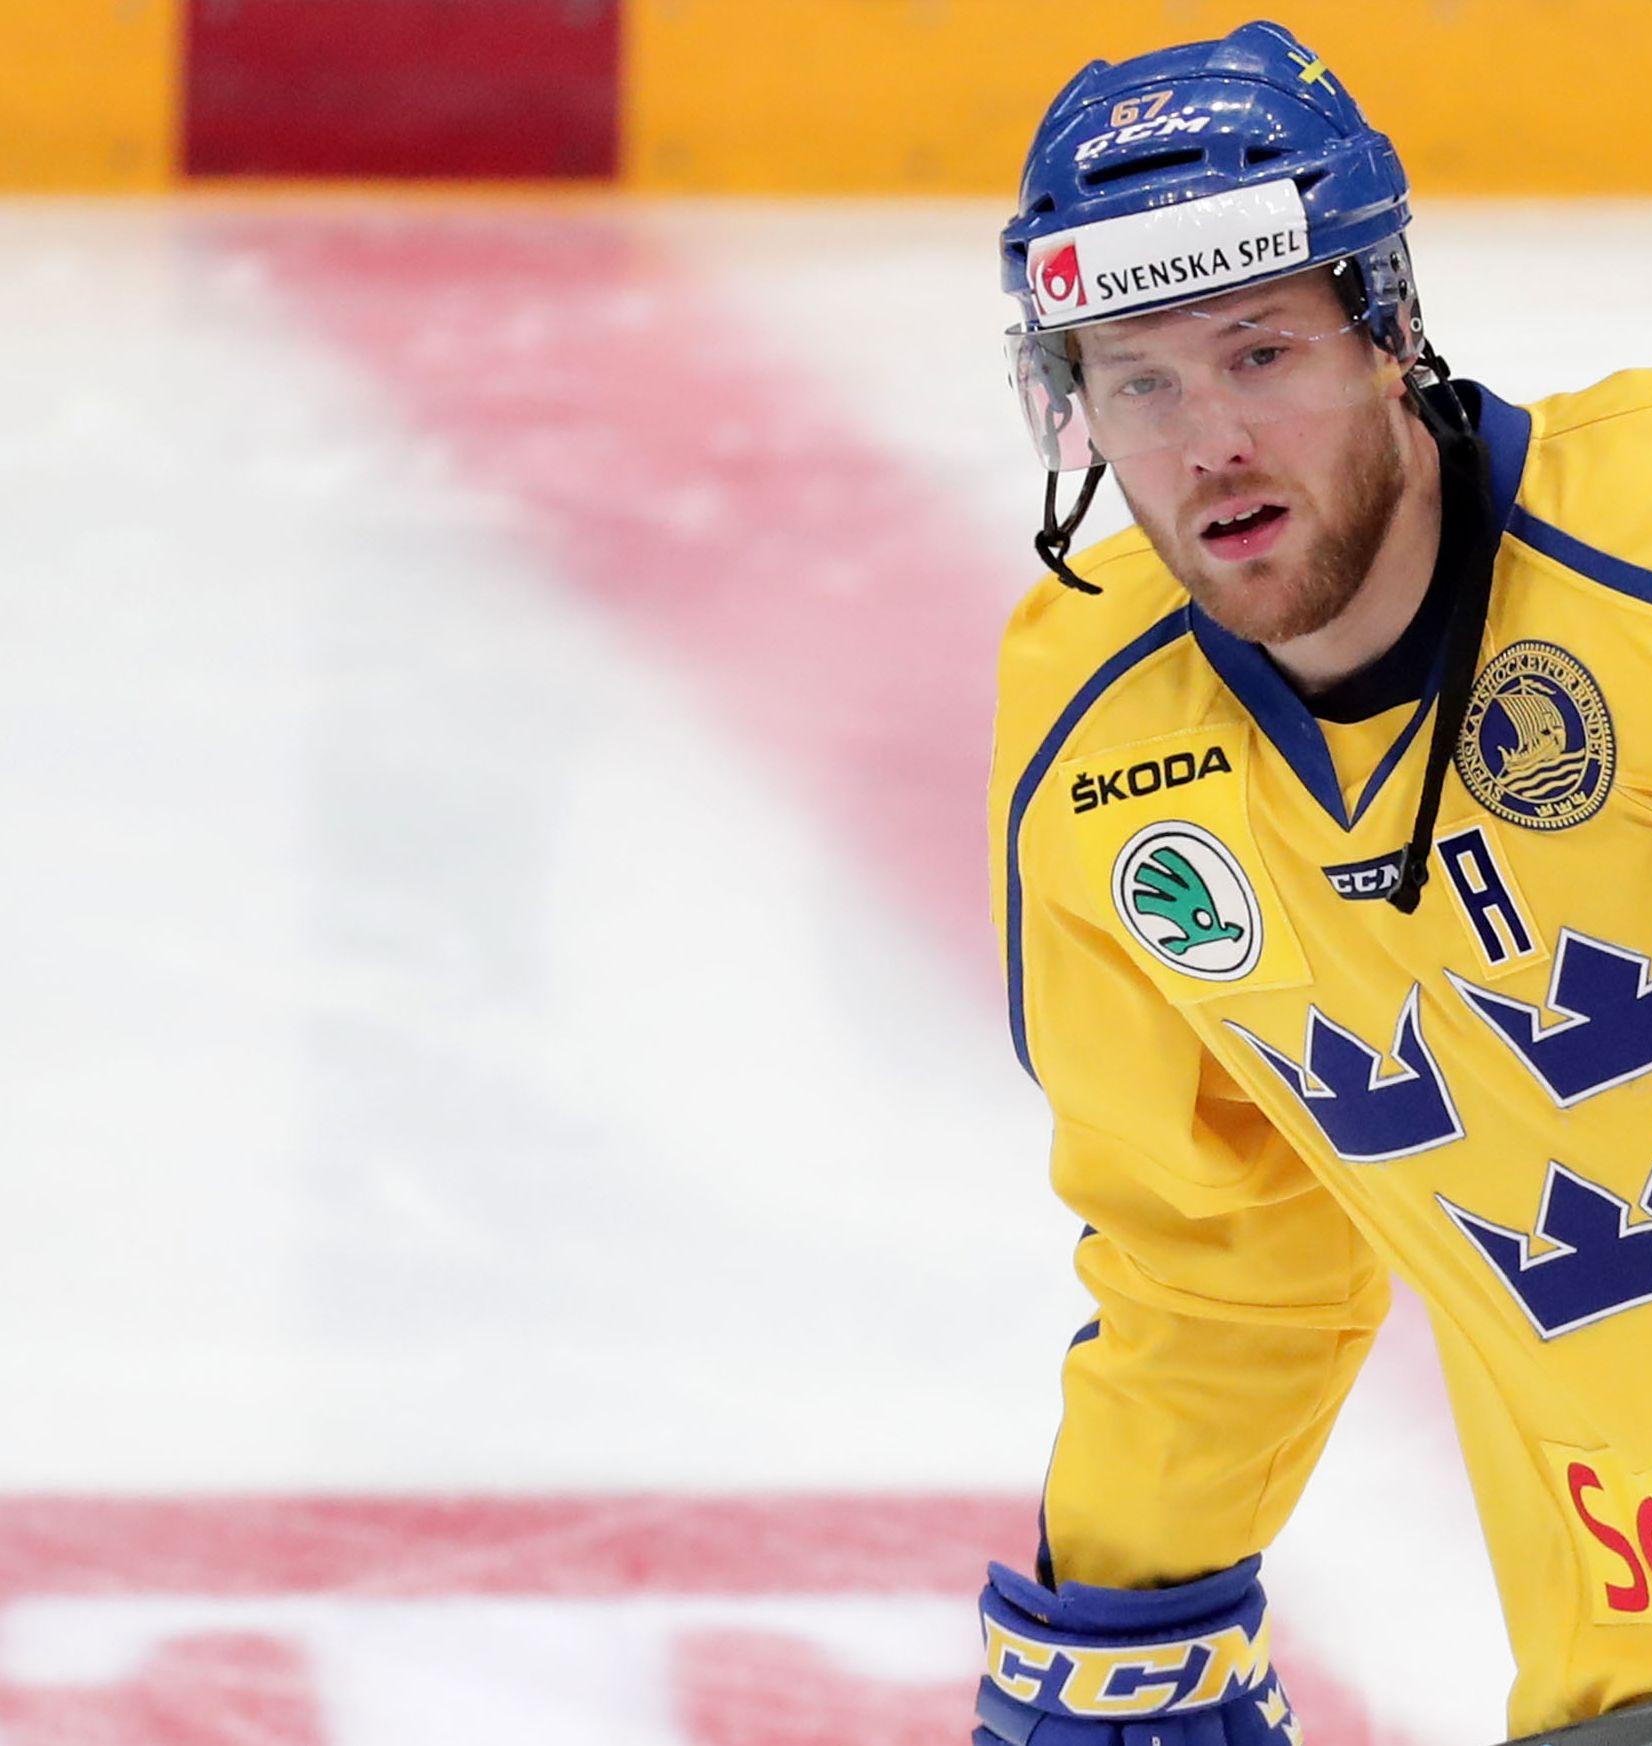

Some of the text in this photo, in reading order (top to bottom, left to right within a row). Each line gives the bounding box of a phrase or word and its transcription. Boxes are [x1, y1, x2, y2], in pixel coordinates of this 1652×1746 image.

[1074, 115, 1211, 162] CCM
[1111, 90, 1174, 128] 67
[1096, 230, 1300, 300] SVENSKA SPEL
[1071, 746, 1232, 814] ŠKODA
[1434, 823, 1536, 968] A
[983, 1606, 1272, 1716] CCM
